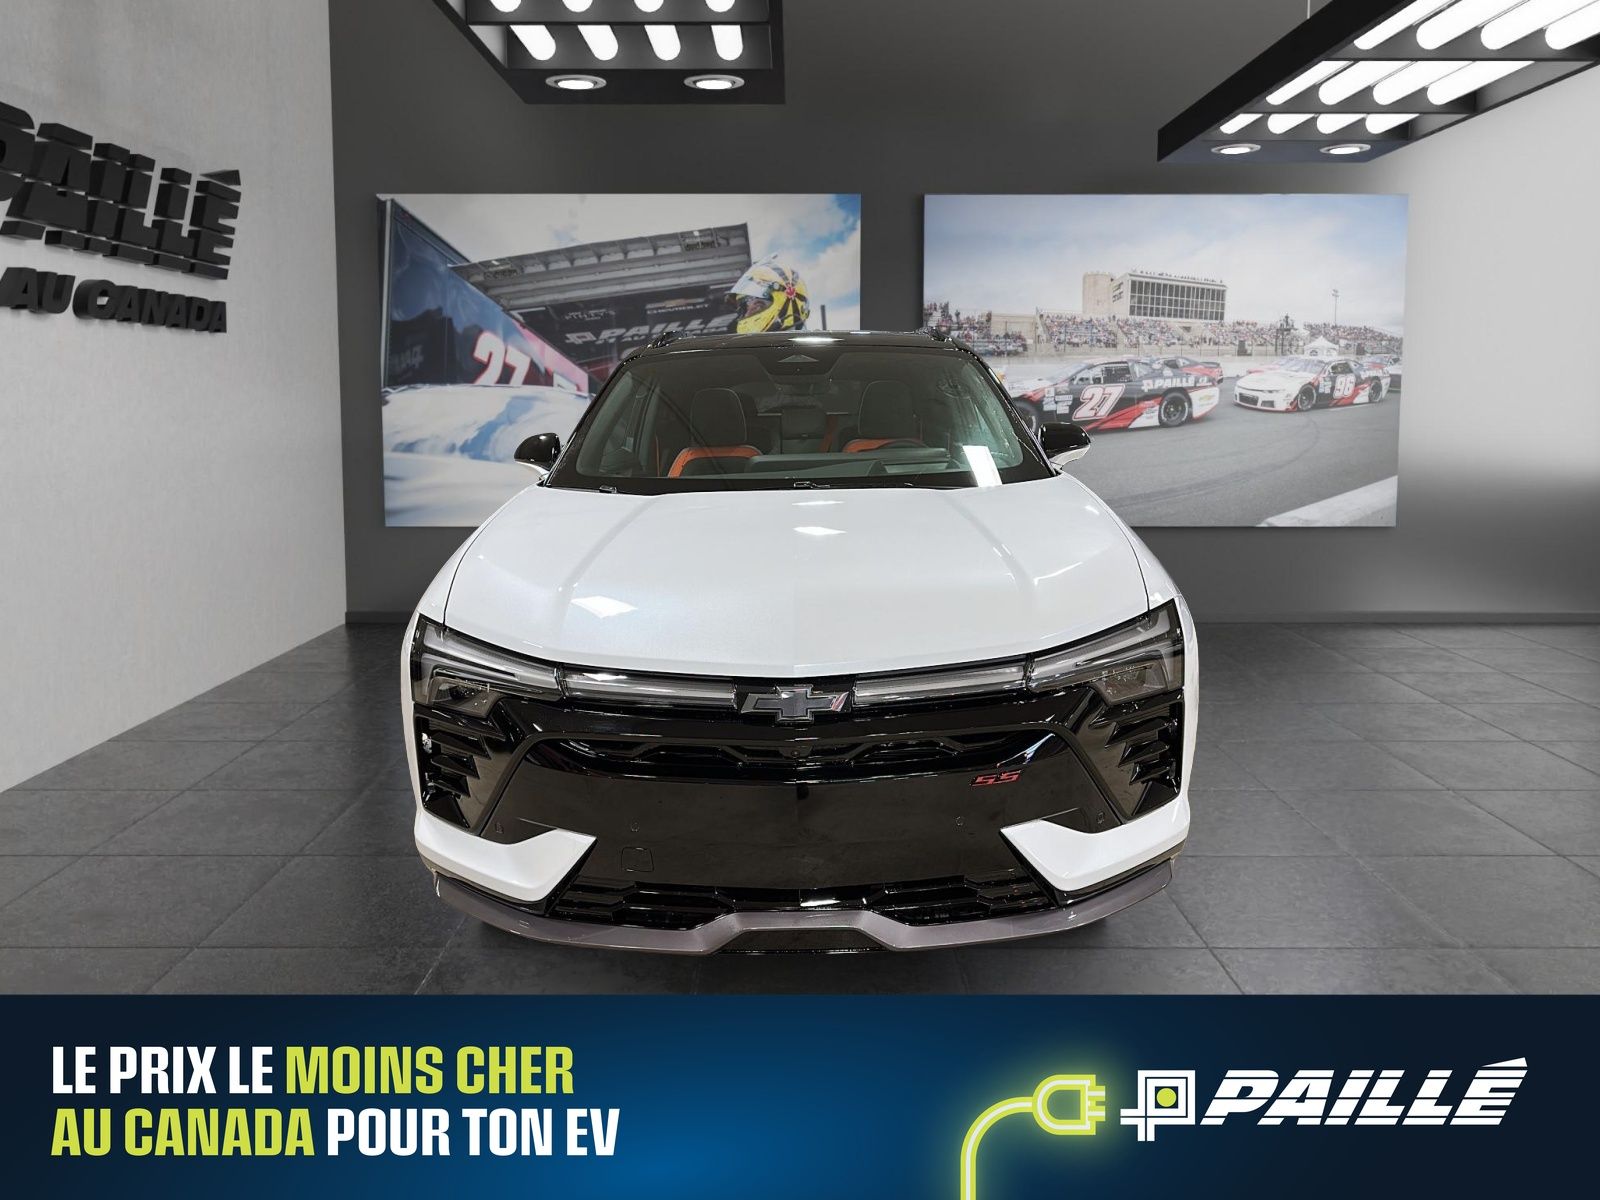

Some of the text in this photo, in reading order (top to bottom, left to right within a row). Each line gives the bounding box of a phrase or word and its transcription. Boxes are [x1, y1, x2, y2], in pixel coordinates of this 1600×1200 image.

[73, 279, 227, 333] CANADA
[473, 332, 530, 385] 27
[1072, 384, 1125, 420] 27
[1333, 373, 1356, 399] 96
[970, 771, 1021, 786] SS
